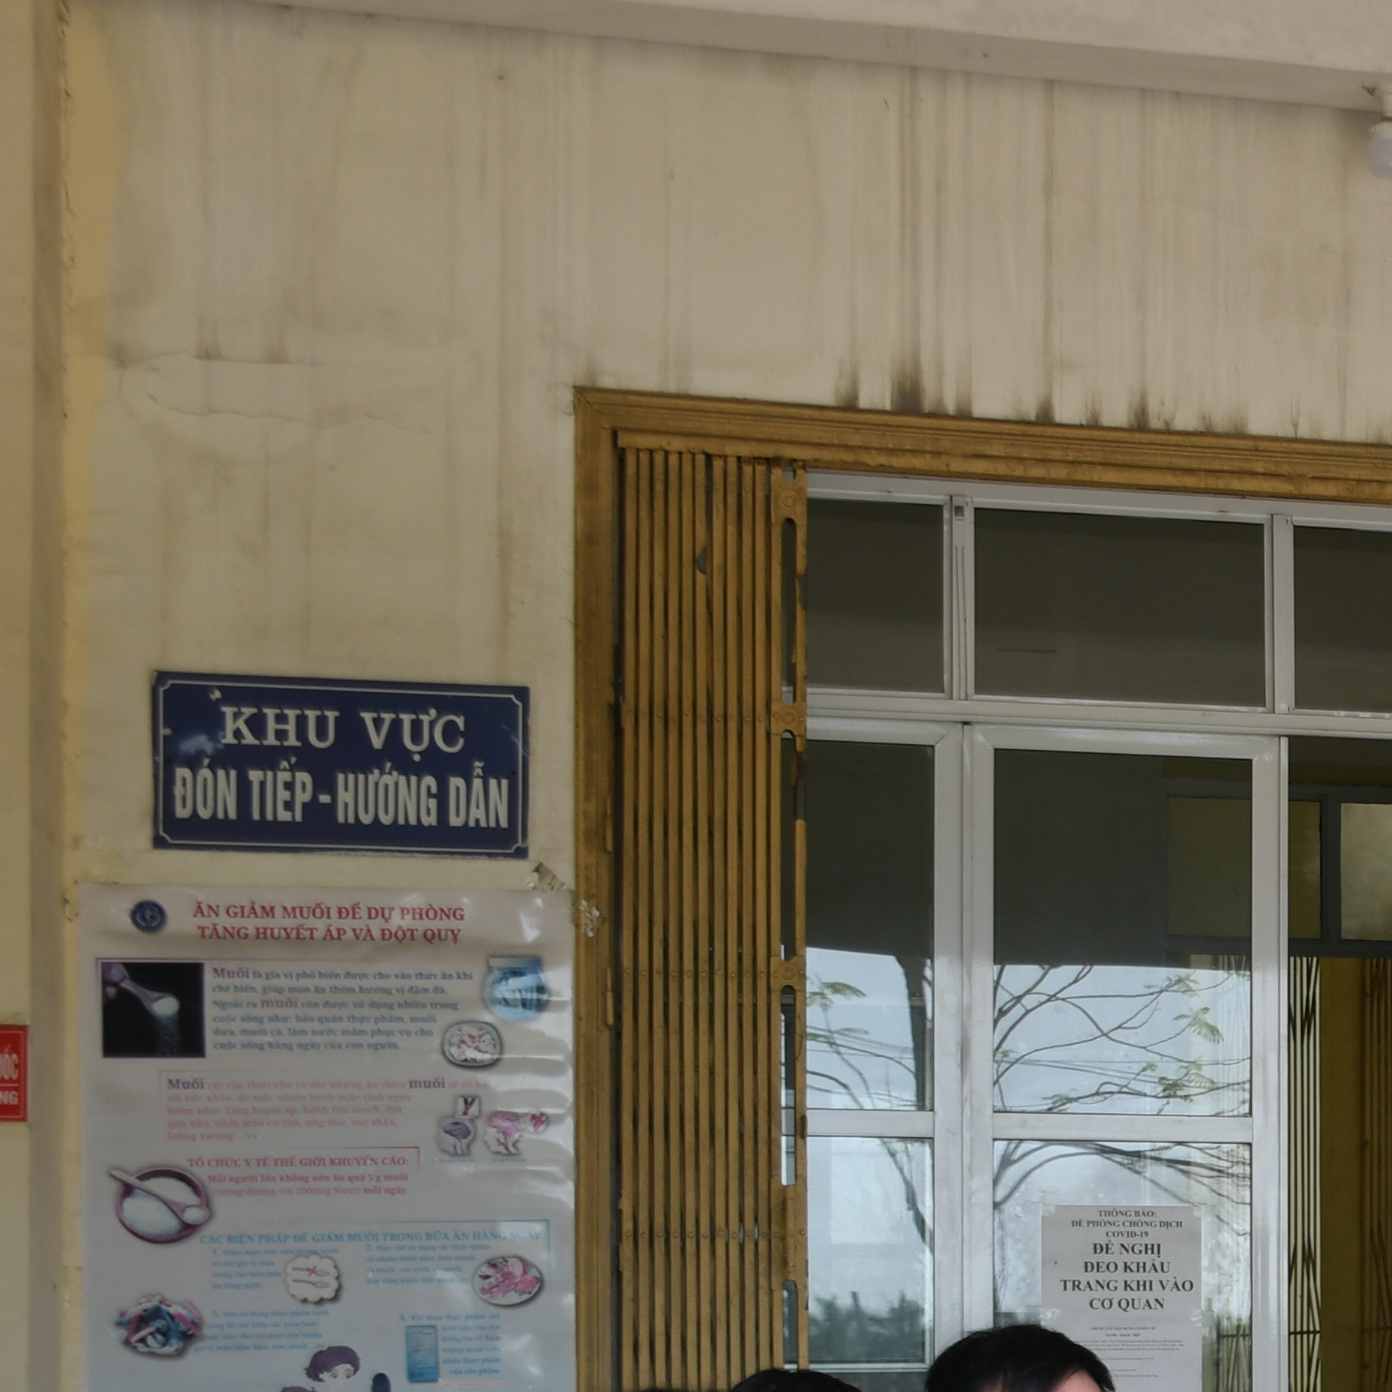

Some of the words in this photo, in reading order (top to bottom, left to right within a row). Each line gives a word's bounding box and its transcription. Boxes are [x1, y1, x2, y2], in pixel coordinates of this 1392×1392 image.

[221, 706, 339, 748] KHU
[360, 707, 465, 762] VỰC
[174, 757, 237, 820] ĐÓN
[248, 756, 313, 822] TIẾP
[337, 764, 437, 826] HƯỚNG
[449, 761, 509, 828] DẪN
[193, 901, 220, 918] ĂN
[225, 901, 276, 919] GIẢM
[282, 902, 331, 919] MUỐI
[337, 902, 362, 920] ĐỂ
[367, 906, 395, 923] DỰ
[399, 904, 464, 921] PHÒNG
[197, 923, 249, 939] TĂNG
[255, 924, 318, 940] HUYẾT
[323, 924, 346, 940] ÁP
[351, 924, 375, 940] VÀ
[380, 925, 418, 944] ĐỘT
[1099, 1208, 1132, 1218] THÔNG
[1159, 1220, 1183, 1229] DỊCH
[1093, 1239, 1115, 1255] ĐỀ
[1120, 1243, 1161, 1258] NGHỊ
[1084, 1261, 1118, 1273] ĐEO
[1123, 1259, 1171, 1273] KHẨU
[1060, 1280, 1118, 1291] TRANG
[1123, 1280, 1153, 1291] KHI
[1159, 1276, 1194, 1292] VÀO
[1089, 1297, 1114, 1310] CƠ
[1118, 1298, 1165, 1312] QUAN
